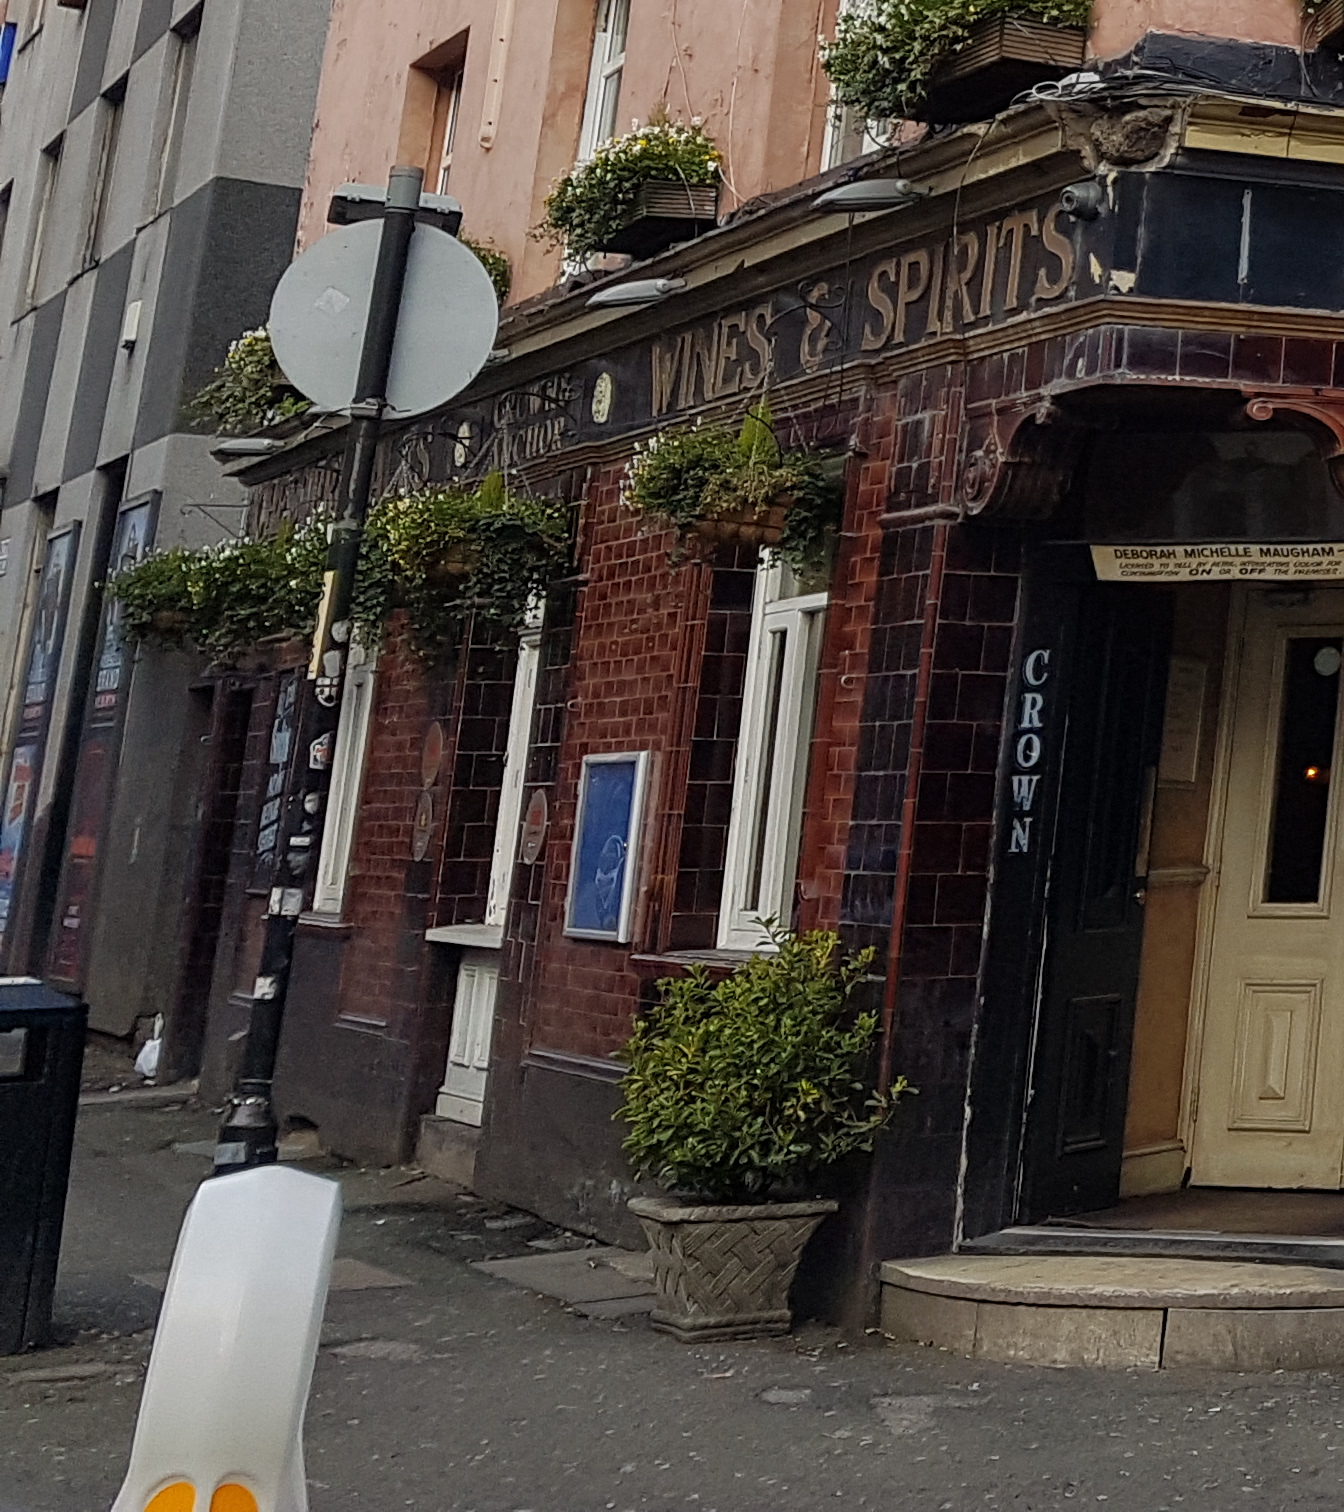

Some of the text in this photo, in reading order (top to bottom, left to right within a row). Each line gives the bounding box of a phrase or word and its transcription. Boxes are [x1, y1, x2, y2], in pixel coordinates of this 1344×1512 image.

[650, 301, 775, 418] WINES
[860, 202, 1077, 353] SPIRITS
[1113, 548, 1177, 560] DEBORAH
[1183, 546, 1253, 559] MICHELLE
[1188, 568, 1212, 576] ON
[1238, 567, 1267, 576] OFF
[1006, 647, 1051, 855] CROWN
